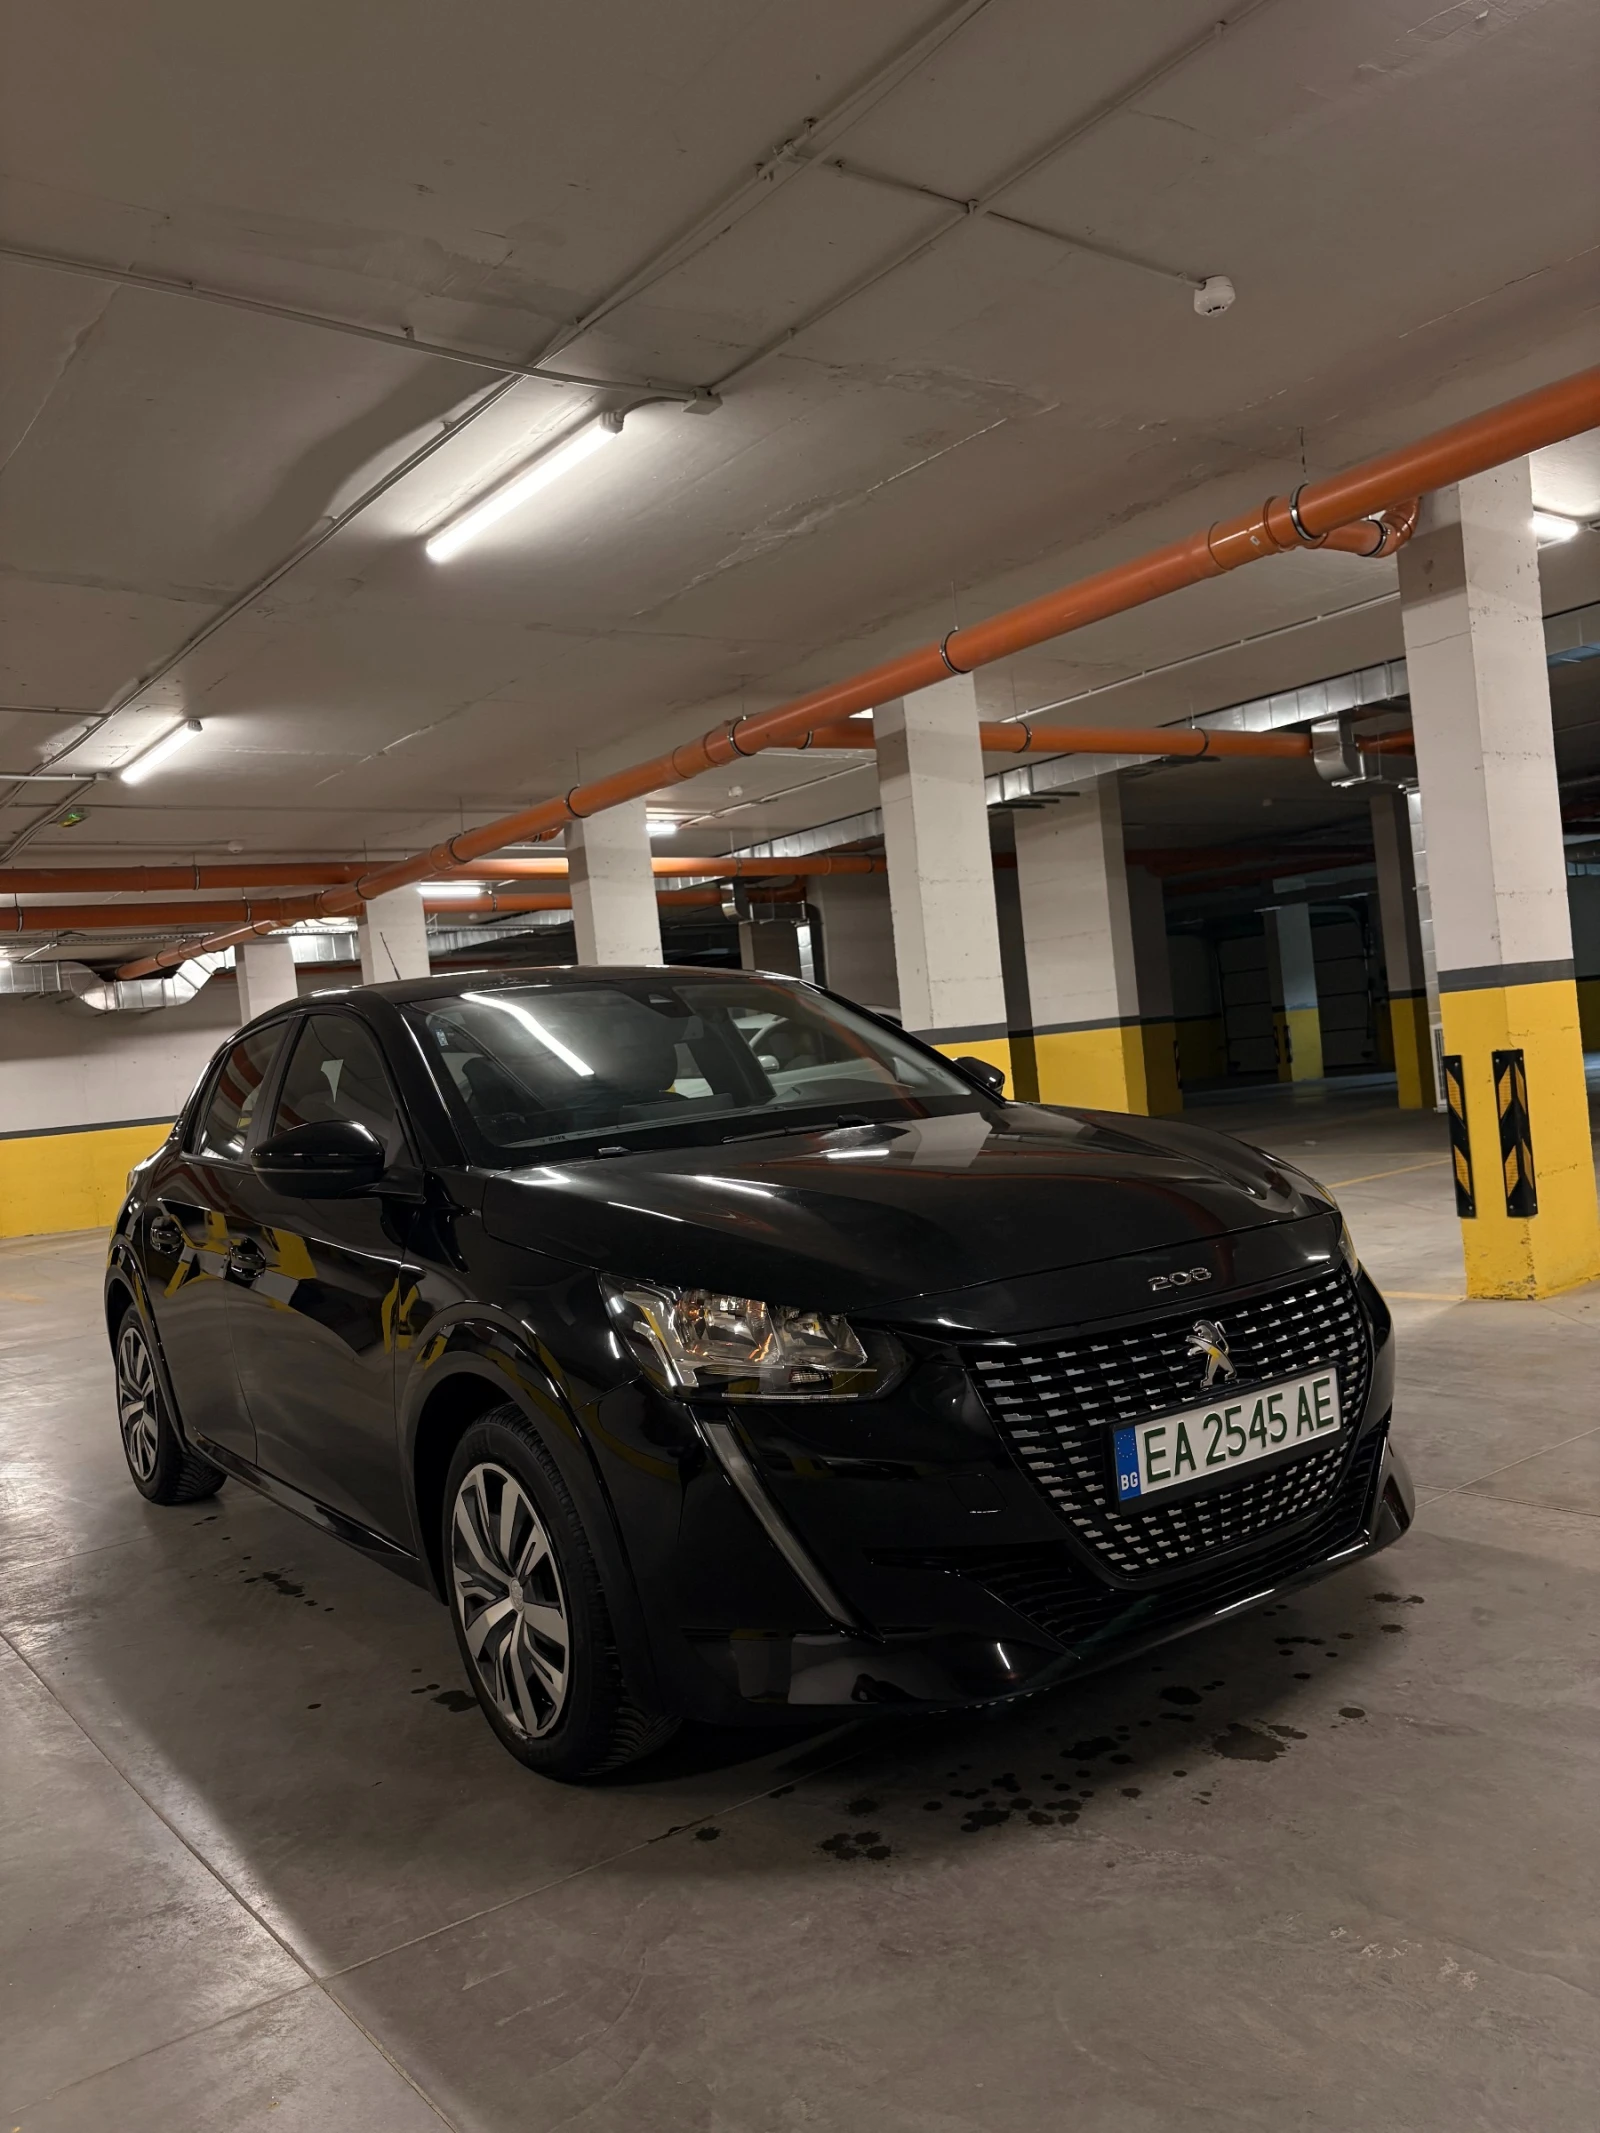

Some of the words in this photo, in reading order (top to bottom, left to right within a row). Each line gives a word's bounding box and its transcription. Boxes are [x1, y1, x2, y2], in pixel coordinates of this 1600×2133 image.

[1148, 1267, 1212, 1291] 208
[1143, 1420, 1197, 1484] EA
[1202, 1392, 1288, 1466] 2545
[1296, 1376, 1334, 1437] AE
[1120, 1471, 1139, 1491] BG
